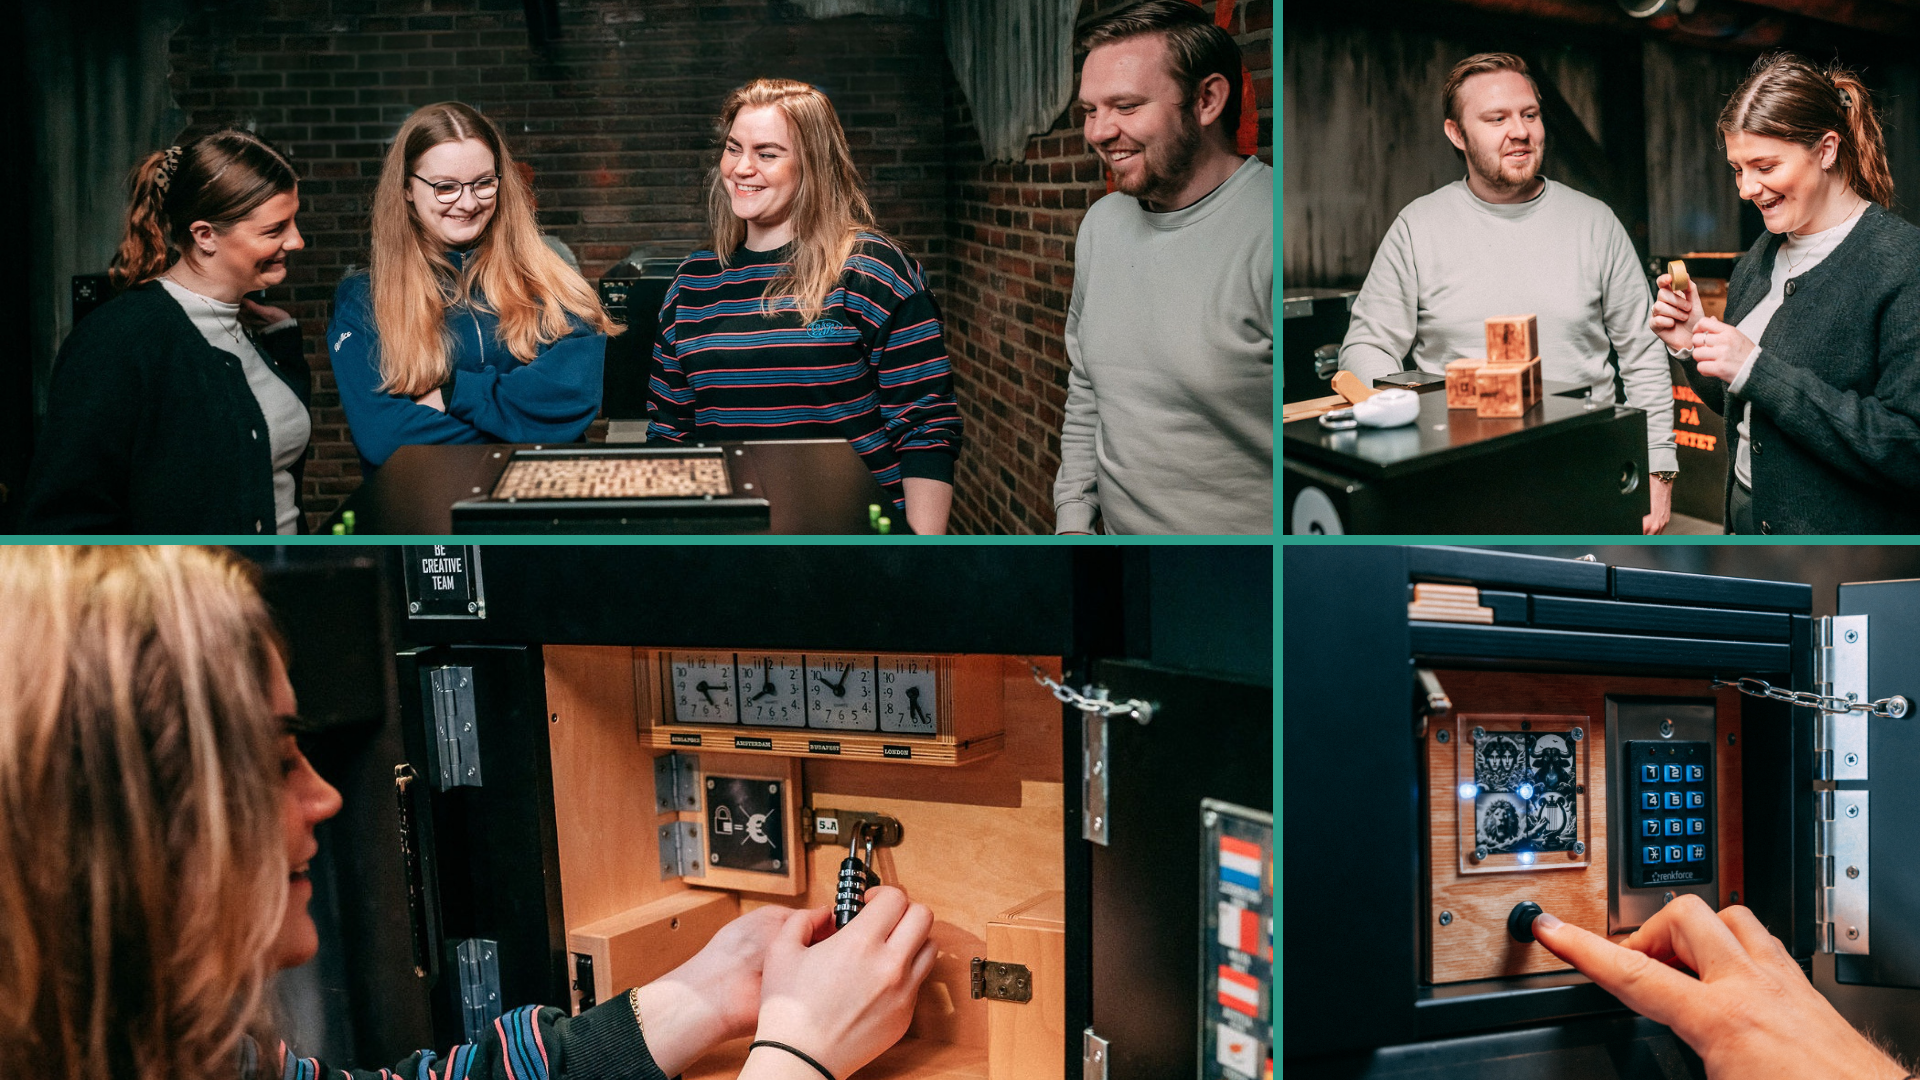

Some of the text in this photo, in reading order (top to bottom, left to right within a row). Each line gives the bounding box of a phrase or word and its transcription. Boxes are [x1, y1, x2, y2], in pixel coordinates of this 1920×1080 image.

[434, 545, 446, 556] BE
[422, 558, 462, 573] CREATIVE
[432, 575, 454, 590] TEAM
[735, 740, 771, 748] AMSTERDAM
[884, 748, 909, 756] LONDON
[1649, 768, 1702, 778] 1 2 3
[1649, 795, 1702, 806] 4 5 6
[1650, 821, 1703, 833] 7 8 9
[1660, 870, 1694, 881] renkforce
